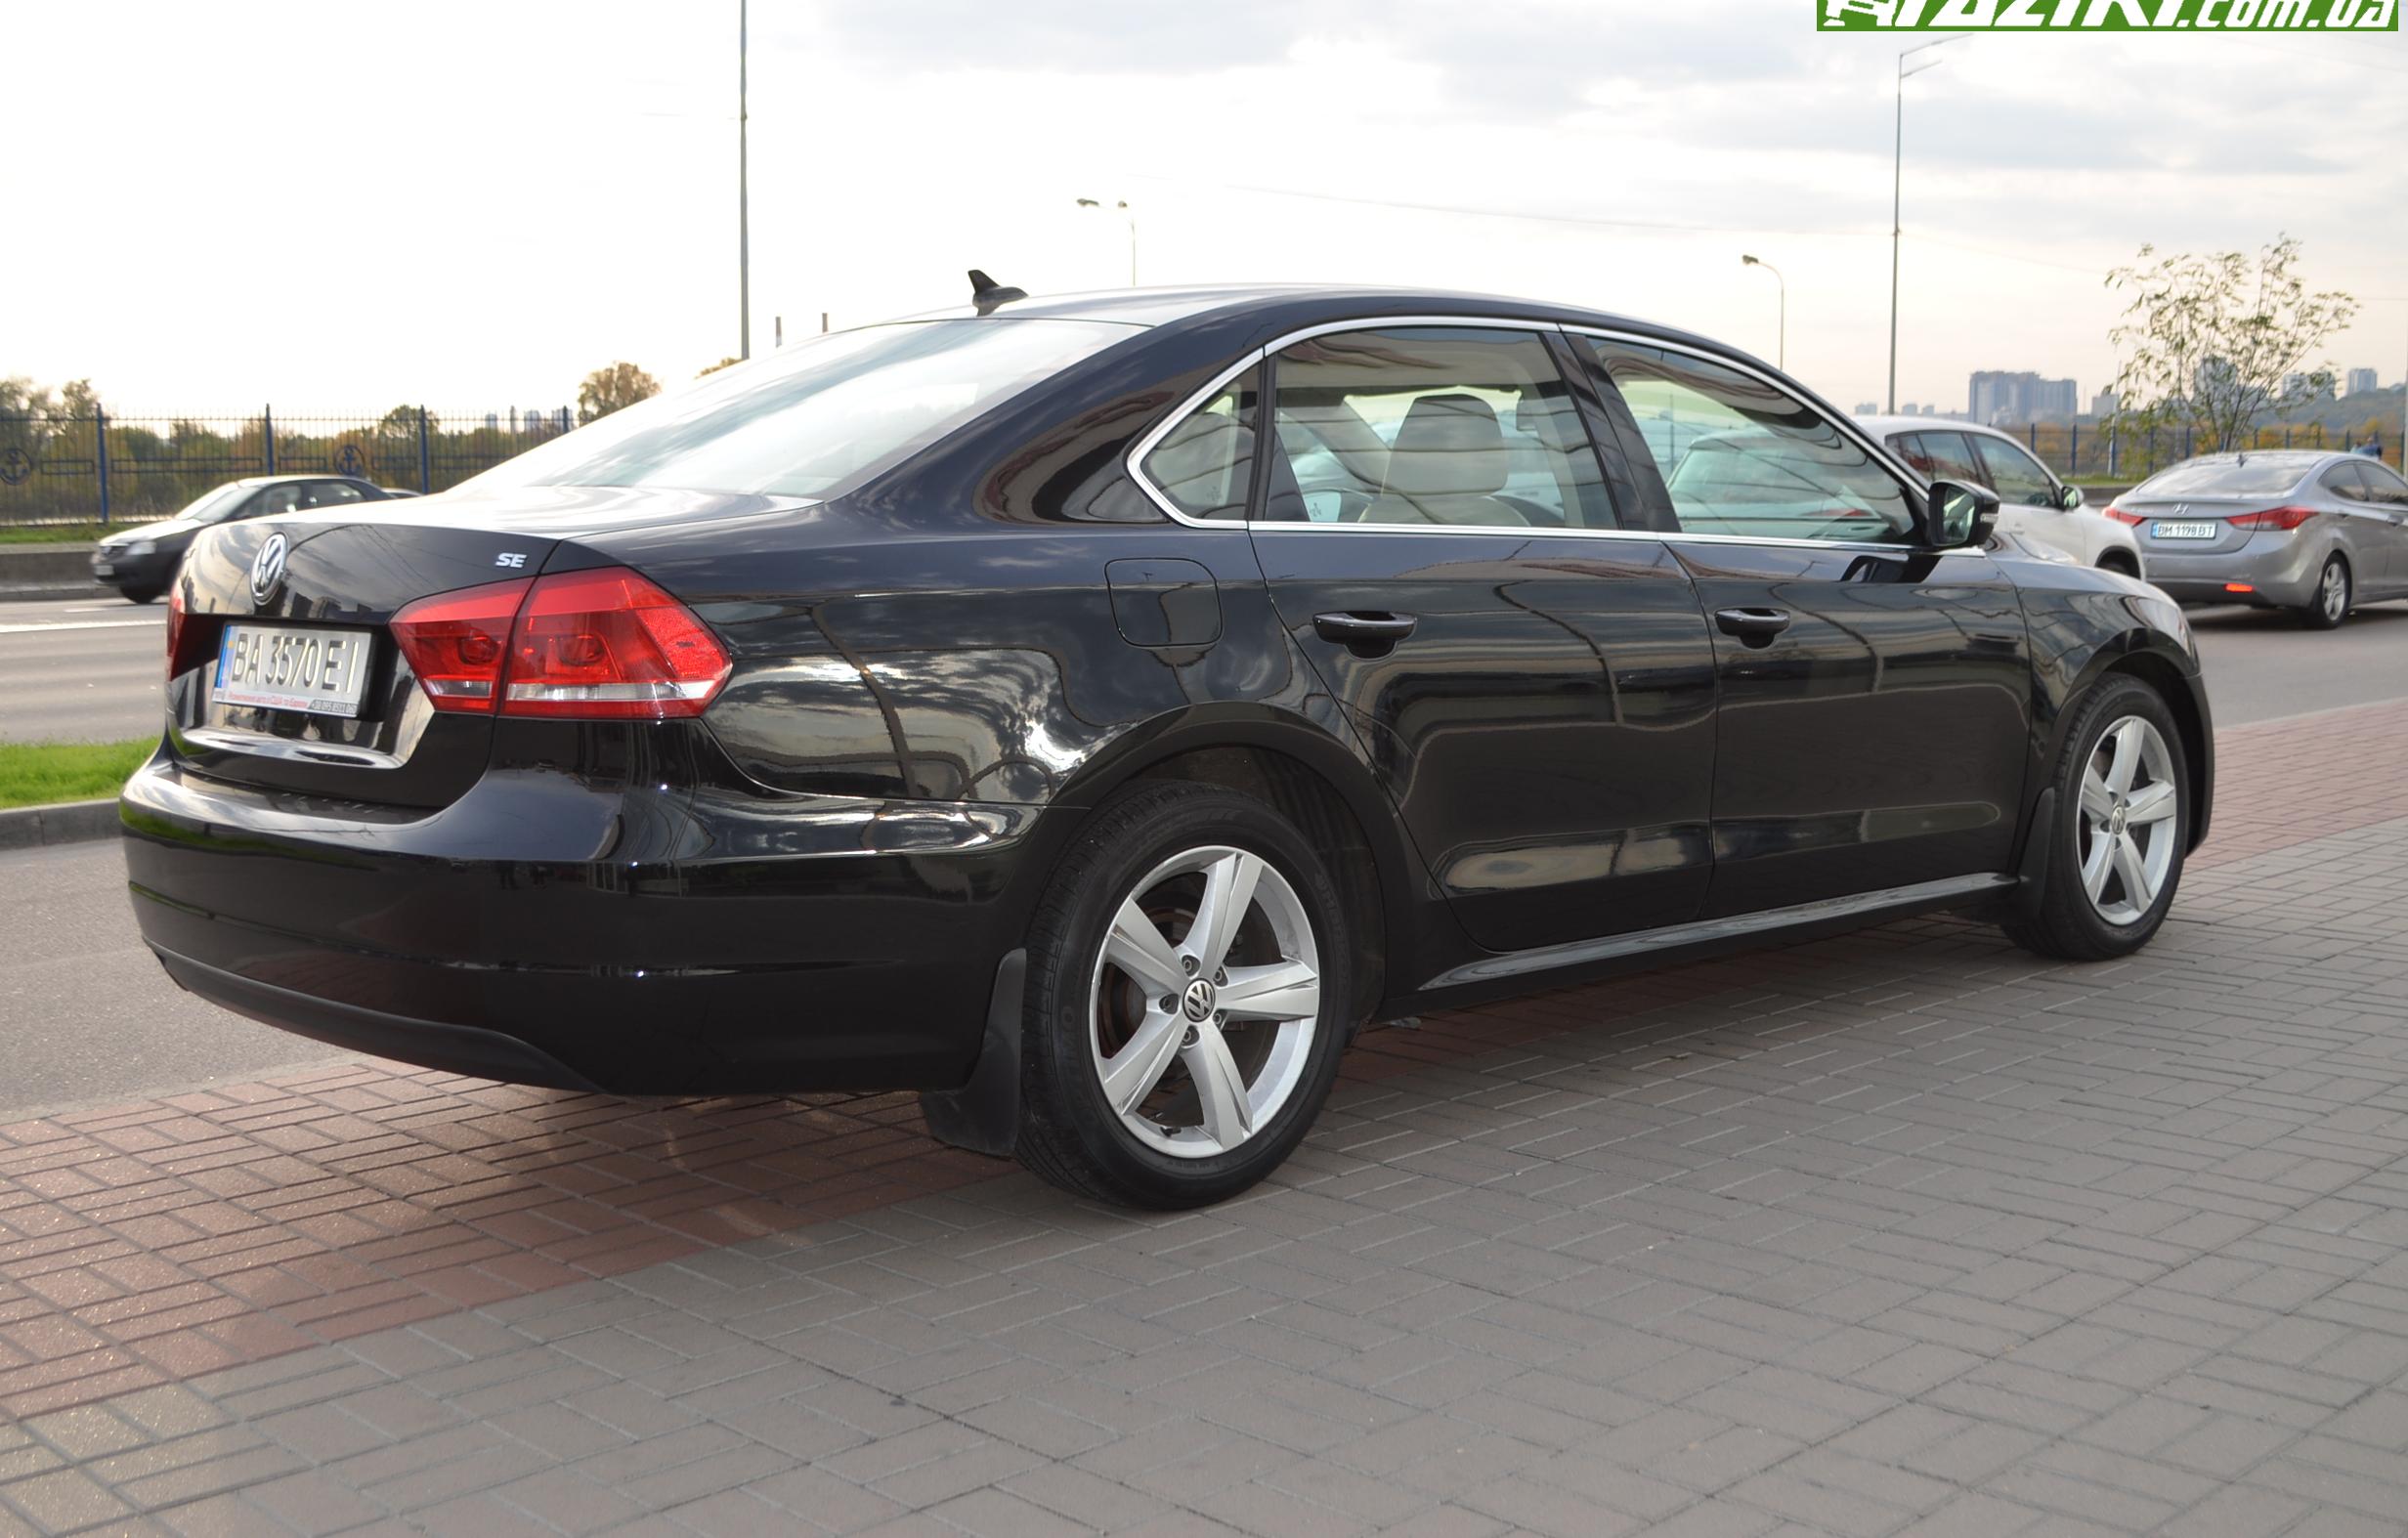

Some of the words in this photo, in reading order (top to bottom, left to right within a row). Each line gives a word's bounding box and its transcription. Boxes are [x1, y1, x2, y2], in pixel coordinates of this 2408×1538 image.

[494, 552, 528, 568] SE
[232, 633, 264, 684] BA
[265, 635, 322, 688] 3570
[322, 639, 360, 694] EI
